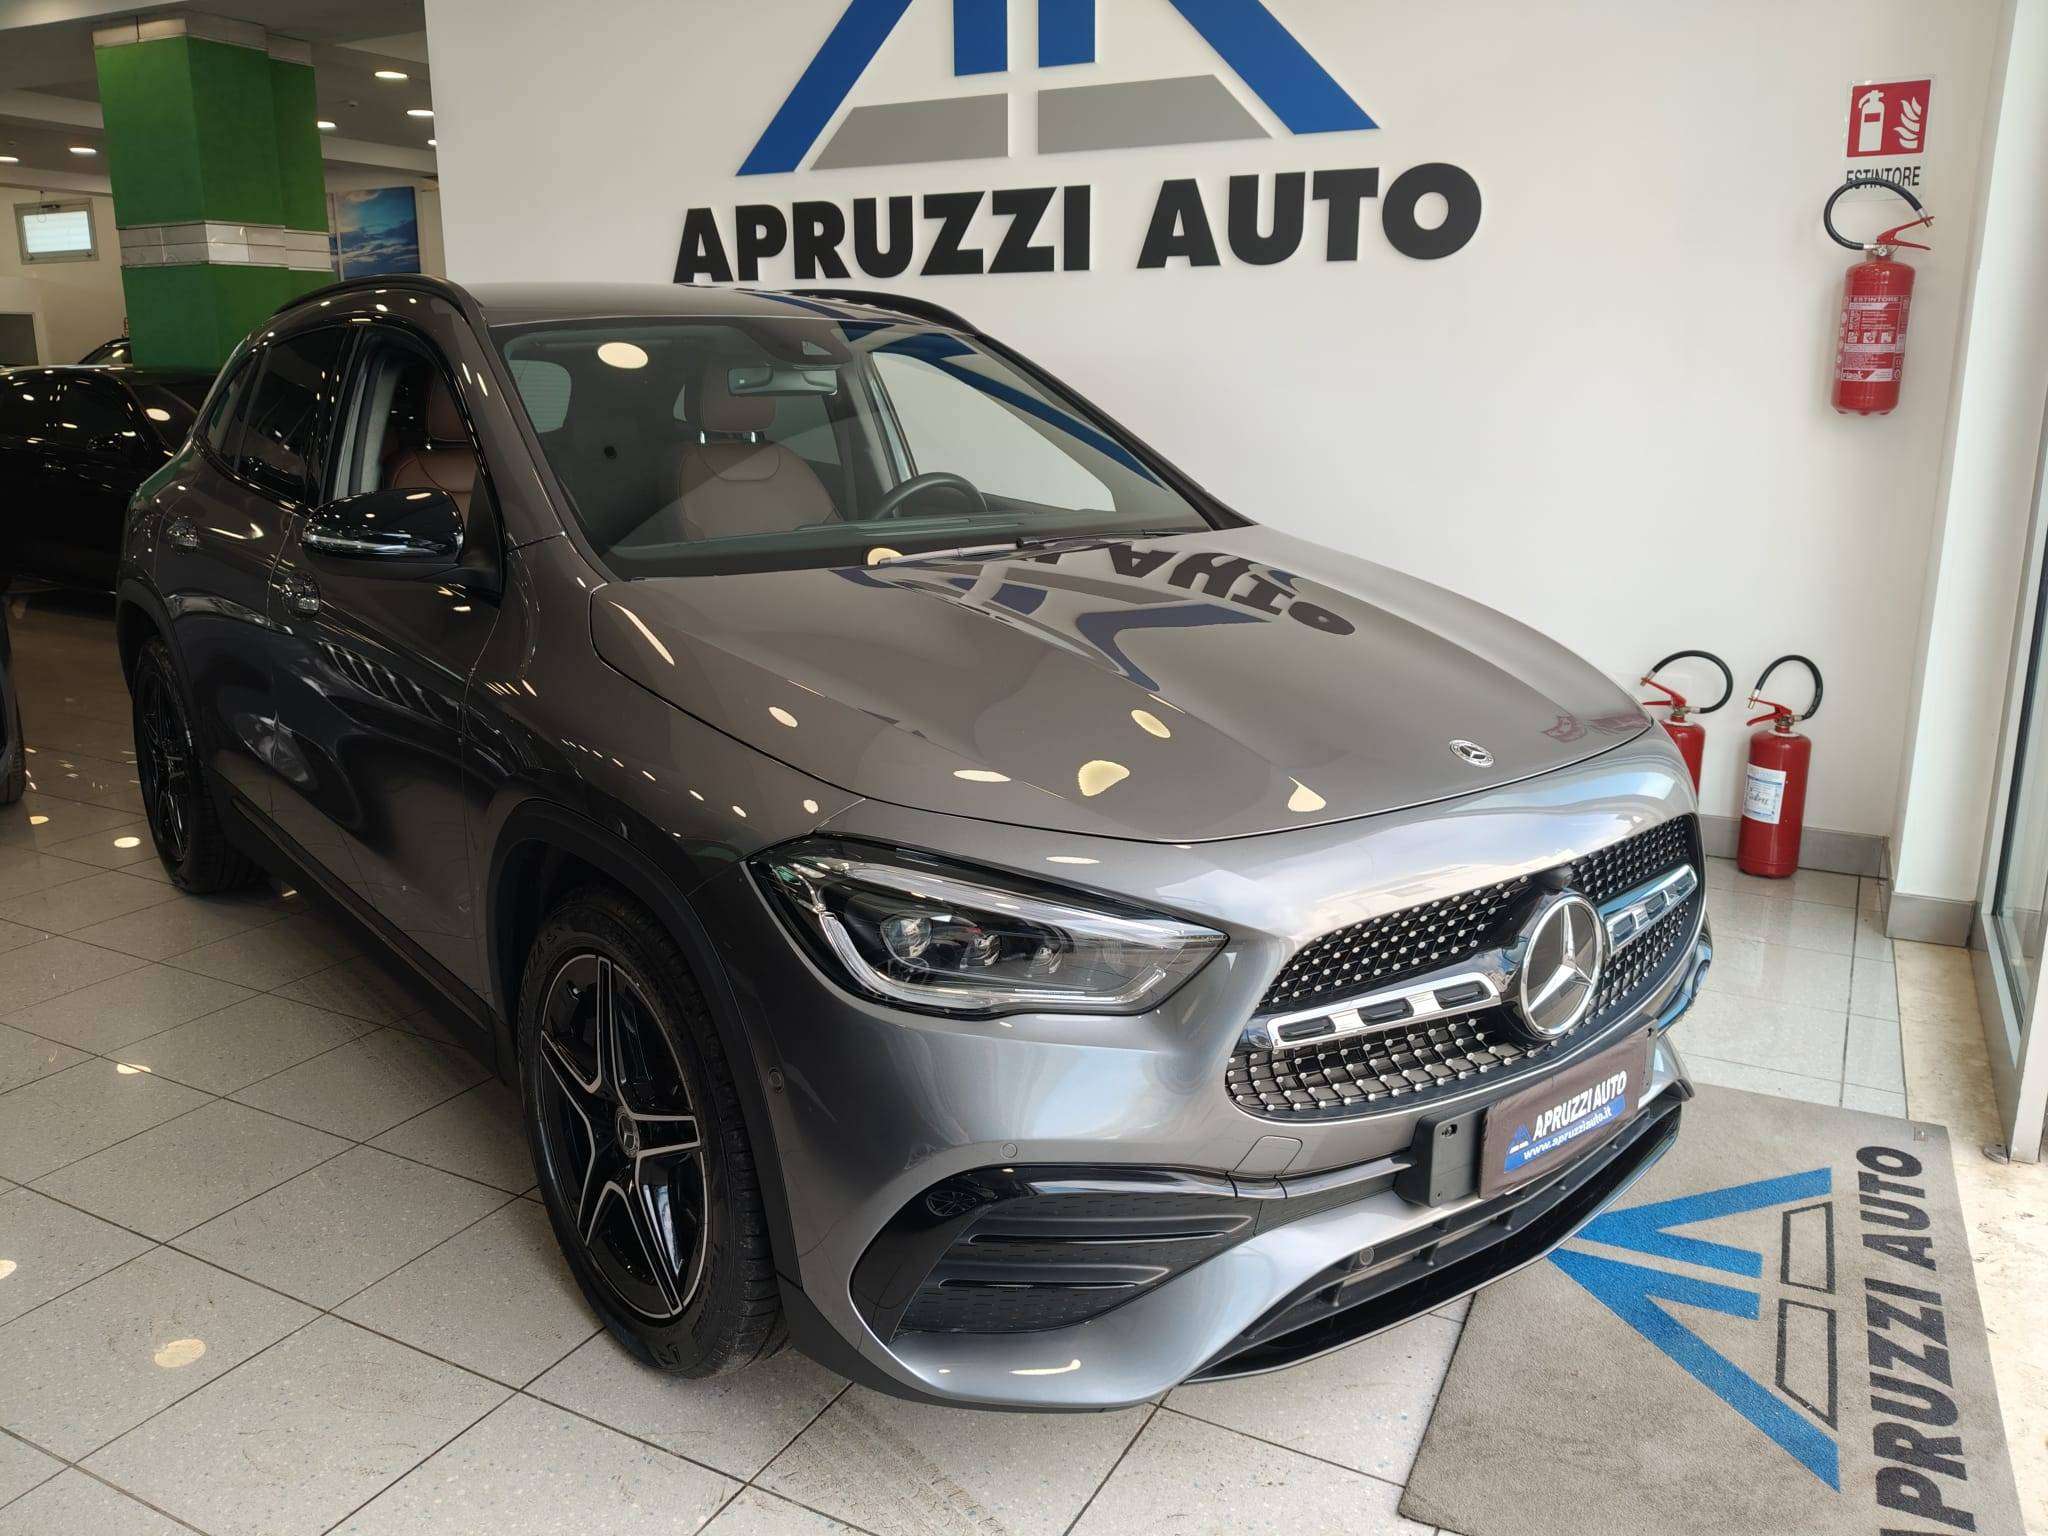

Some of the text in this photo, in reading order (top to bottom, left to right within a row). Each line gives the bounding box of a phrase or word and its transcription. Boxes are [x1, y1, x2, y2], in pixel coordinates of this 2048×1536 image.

[1846, 166, 1921, 189] ESTINTORE
[673, 162, 1482, 283] APRUZZI AUTO
[1523, 1106, 1612, 1160] www.apruzziauto.it
[1533, 1070, 1628, 1141] APRUZZI AUTO
[1856, 1145, 1977, 1536] PRUZZI AUTO
